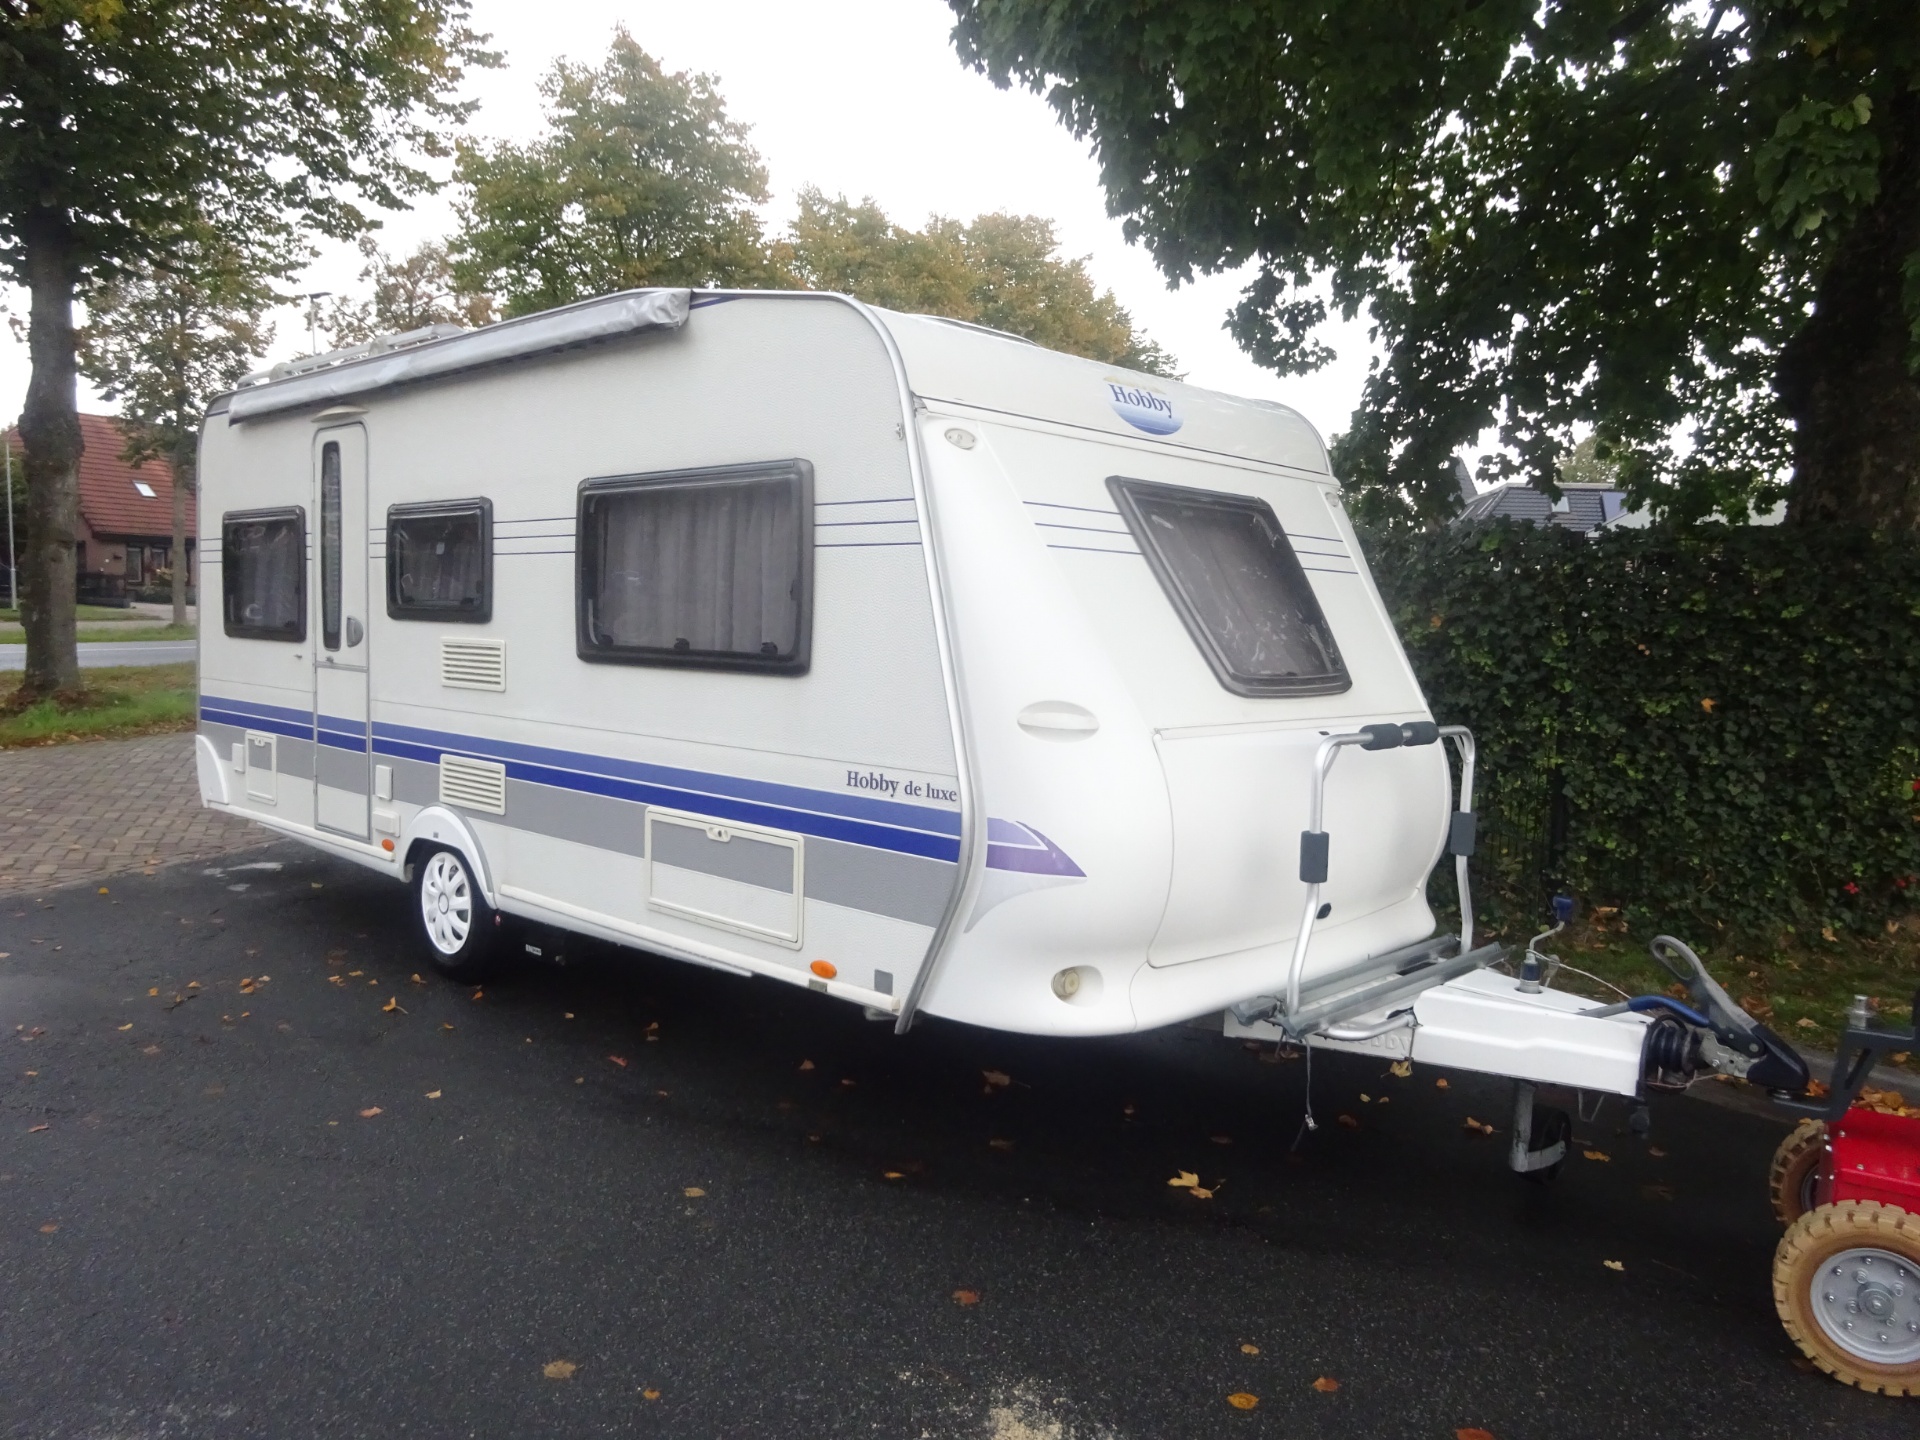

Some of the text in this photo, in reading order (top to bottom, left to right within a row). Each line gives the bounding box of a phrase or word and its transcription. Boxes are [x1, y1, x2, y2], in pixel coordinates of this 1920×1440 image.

[1108, 384, 1172, 419] Hobby
[846, 770, 957, 802] Hobby de luxe
